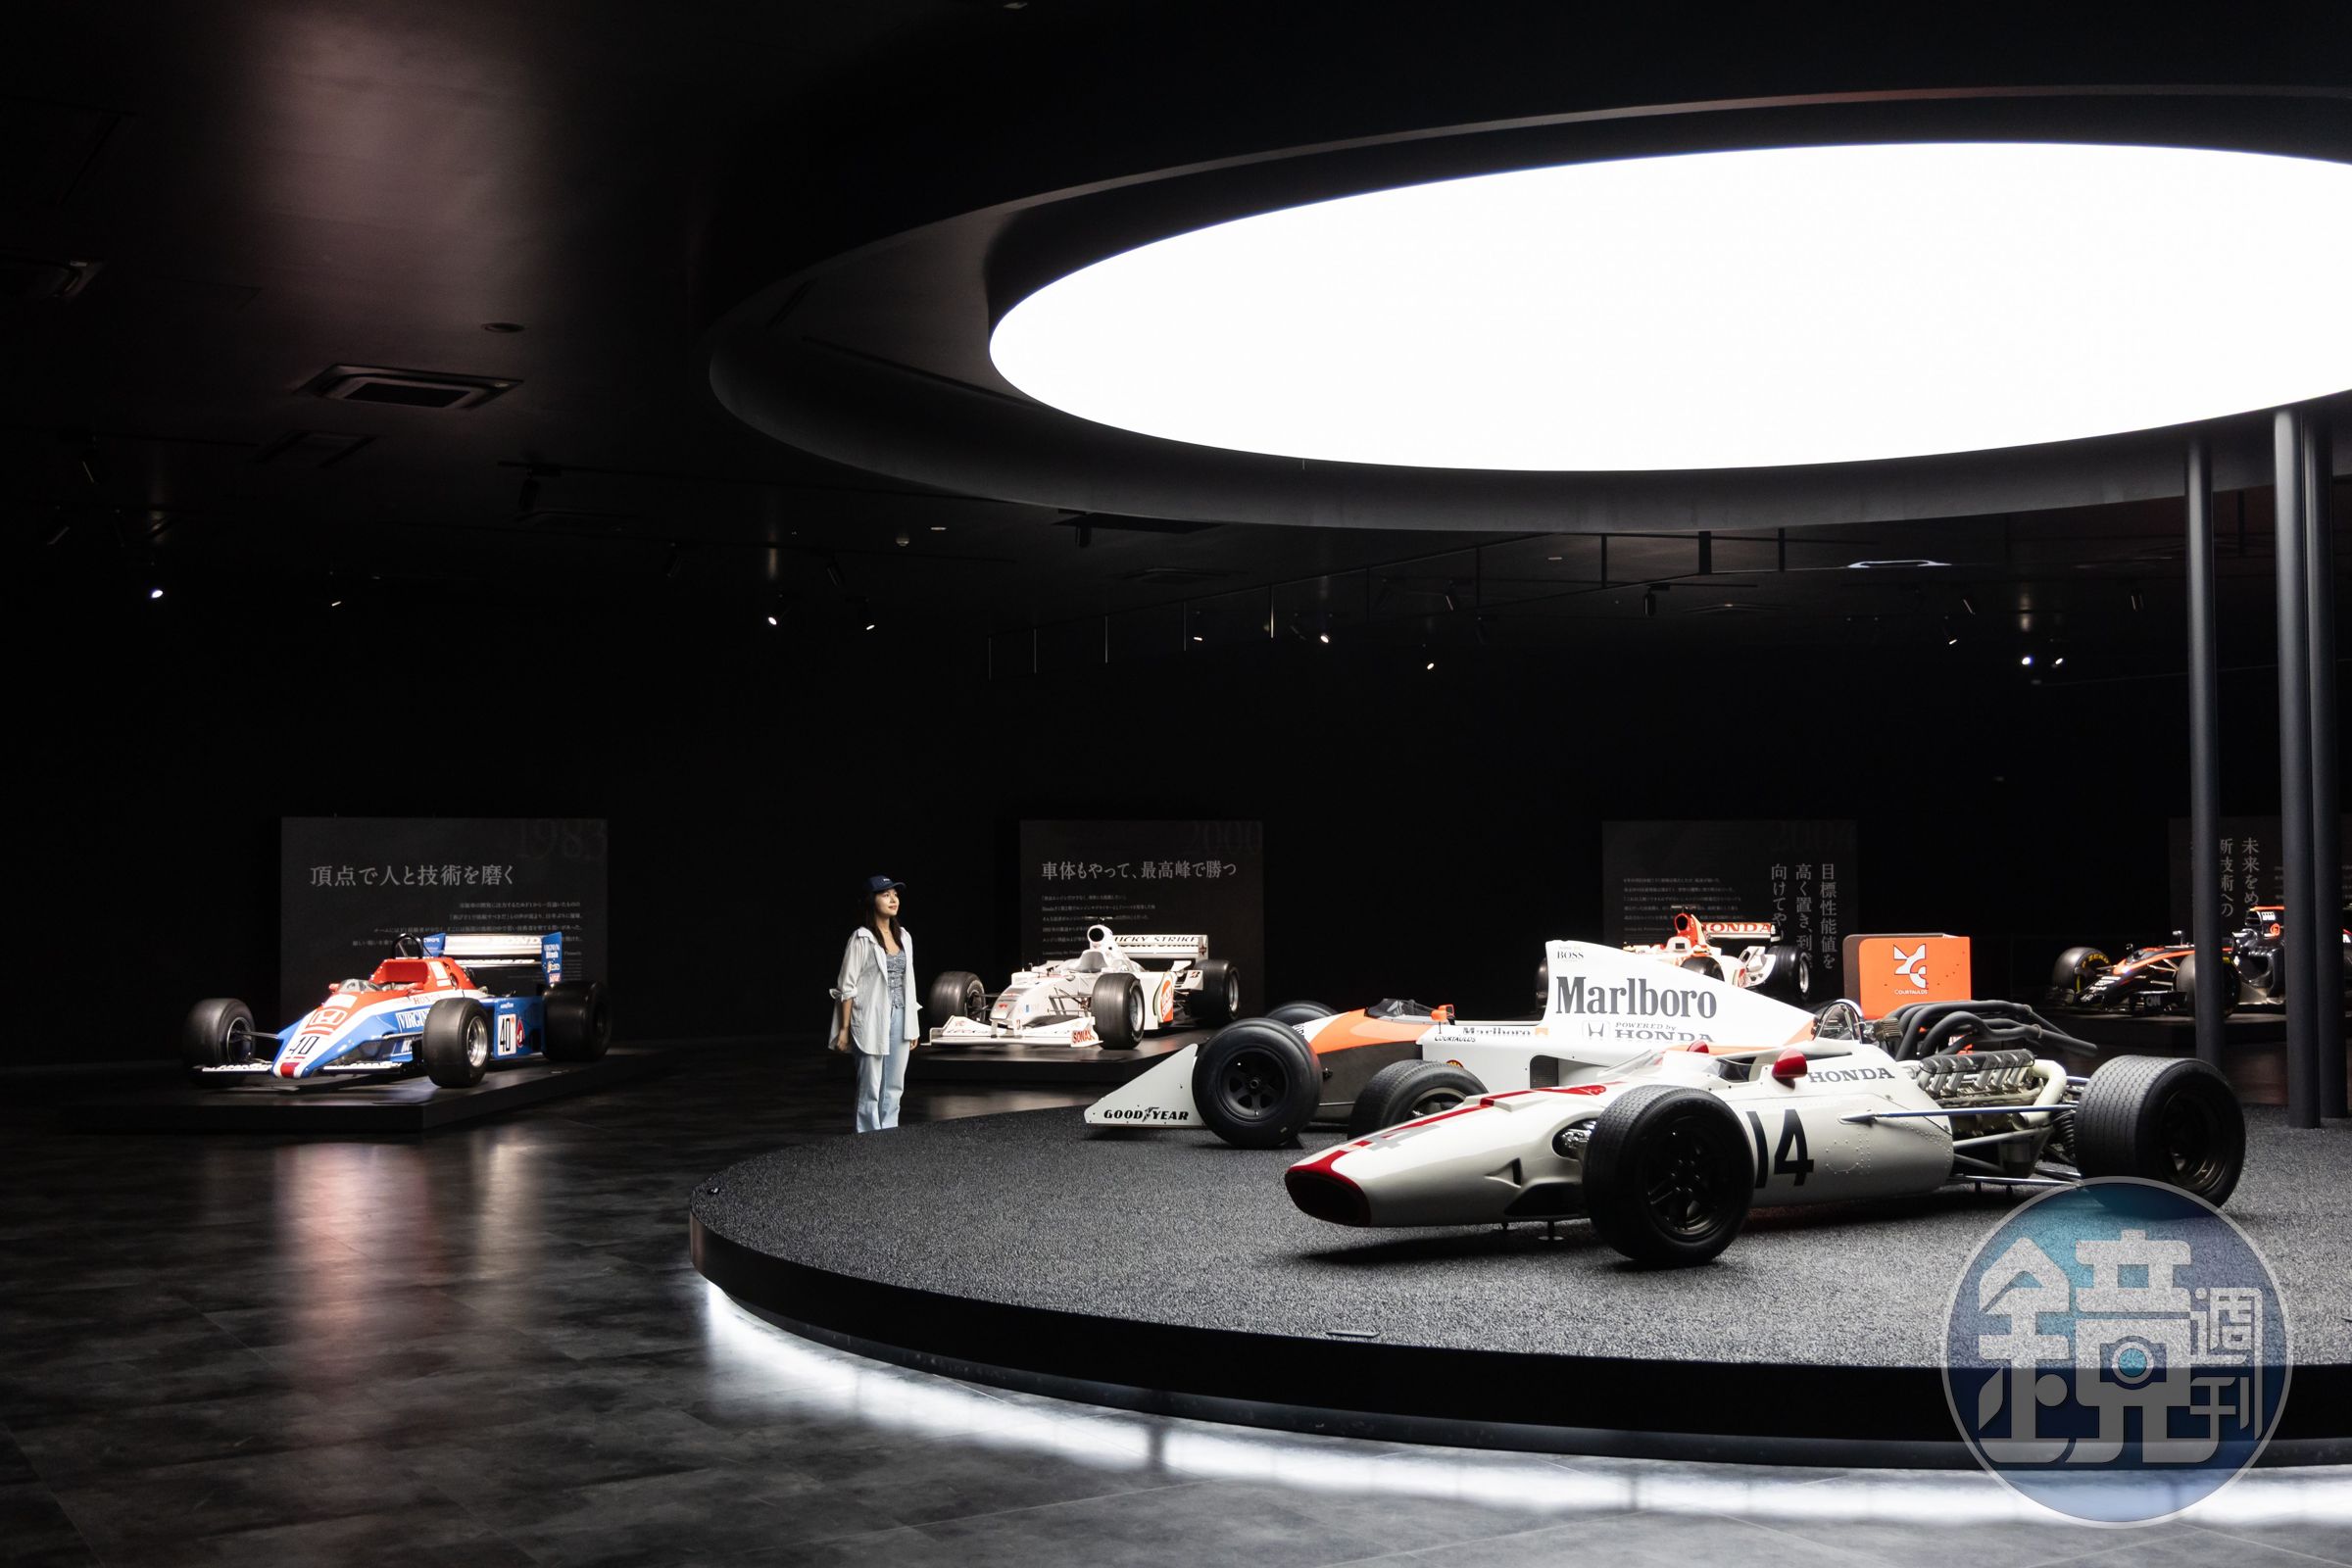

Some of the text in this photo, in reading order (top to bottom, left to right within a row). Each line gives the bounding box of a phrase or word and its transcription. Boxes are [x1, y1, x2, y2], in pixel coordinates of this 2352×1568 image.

[310, 864, 515, 887] 頂点で人と技術を磨く
[1042, 859, 1238, 881] 車体もやって、最高峰で勝つ
[2241, 836, 2260, 906] 未来をめ
[1820, 862, 1838, 969] 目標性能値を
[1556, 950, 1585, 959] BOSS
[1555, 975, 1717, 1019] Marlboro
[499, 1017, 511, 1053] 40
[1614, 1029, 1715, 1043] HONDA
[1615, 1021, 1664, 1030] POWERED
[289, 1035, 319, 1054] 40
[1807, 1067, 1895, 1083] HONDA
[1745, 1108, 1815, 1189] 14
